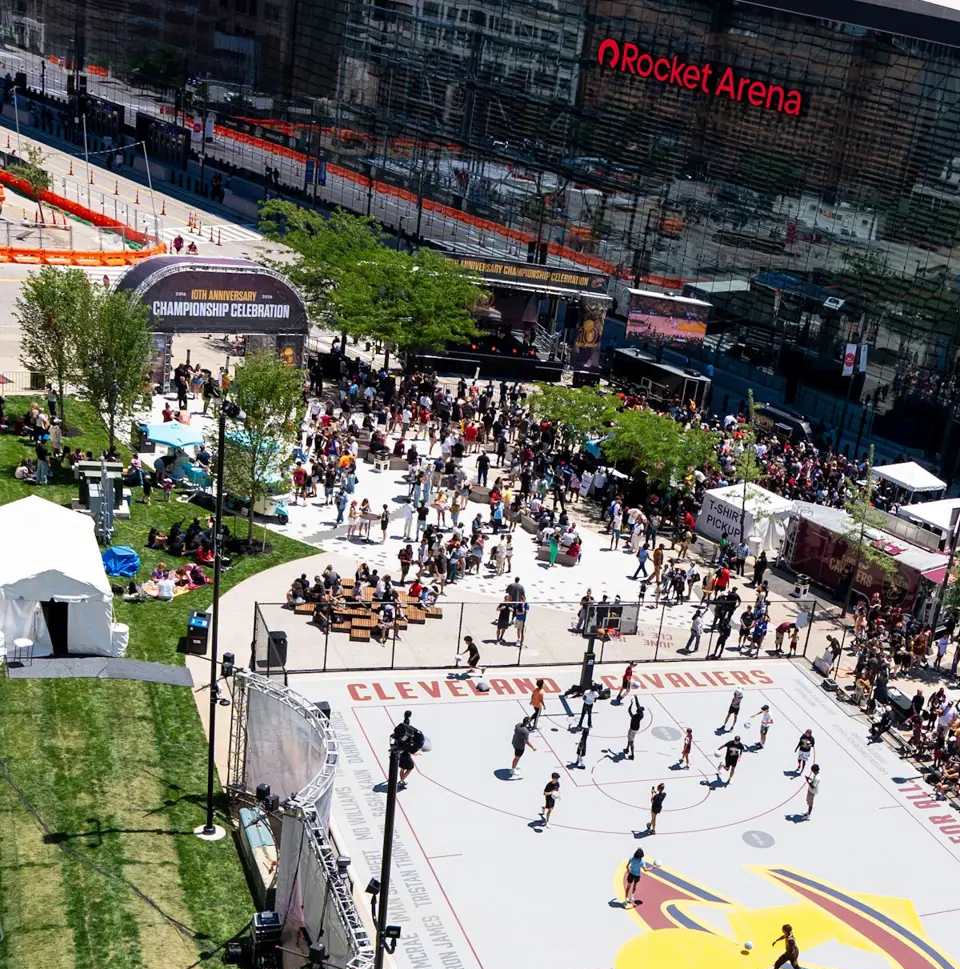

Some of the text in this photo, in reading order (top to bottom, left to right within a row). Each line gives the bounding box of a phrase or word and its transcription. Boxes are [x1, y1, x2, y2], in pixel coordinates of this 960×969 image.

[621, 42, 802, 116] Rocket Arena
[459, 259, 503, 274] ANNIVERSARY
[503, 266, 550, 280] CHAMPIONSHIP
[551, 272, 589, 286] CELEBRATION
[153, 301, 290, 318] CHAMPIONSHIP CELEBRATION
[191, 289, 257, 302] 10TH ANNIVERSARY
[706, 514, 741, 537] PICKUP
[708, 500, 745, 526] T-SHIRT
[829, 558, 873, 588] CAVERS
[347, 677, 562, 701] CLEVELAND
[334, 786, 368, 827] WILLIAMS
[400, 870, 432, 908] TRISTAN
[421, 915, 454, 949] JAMES
[400, 932, 433, 969] MCRAE
